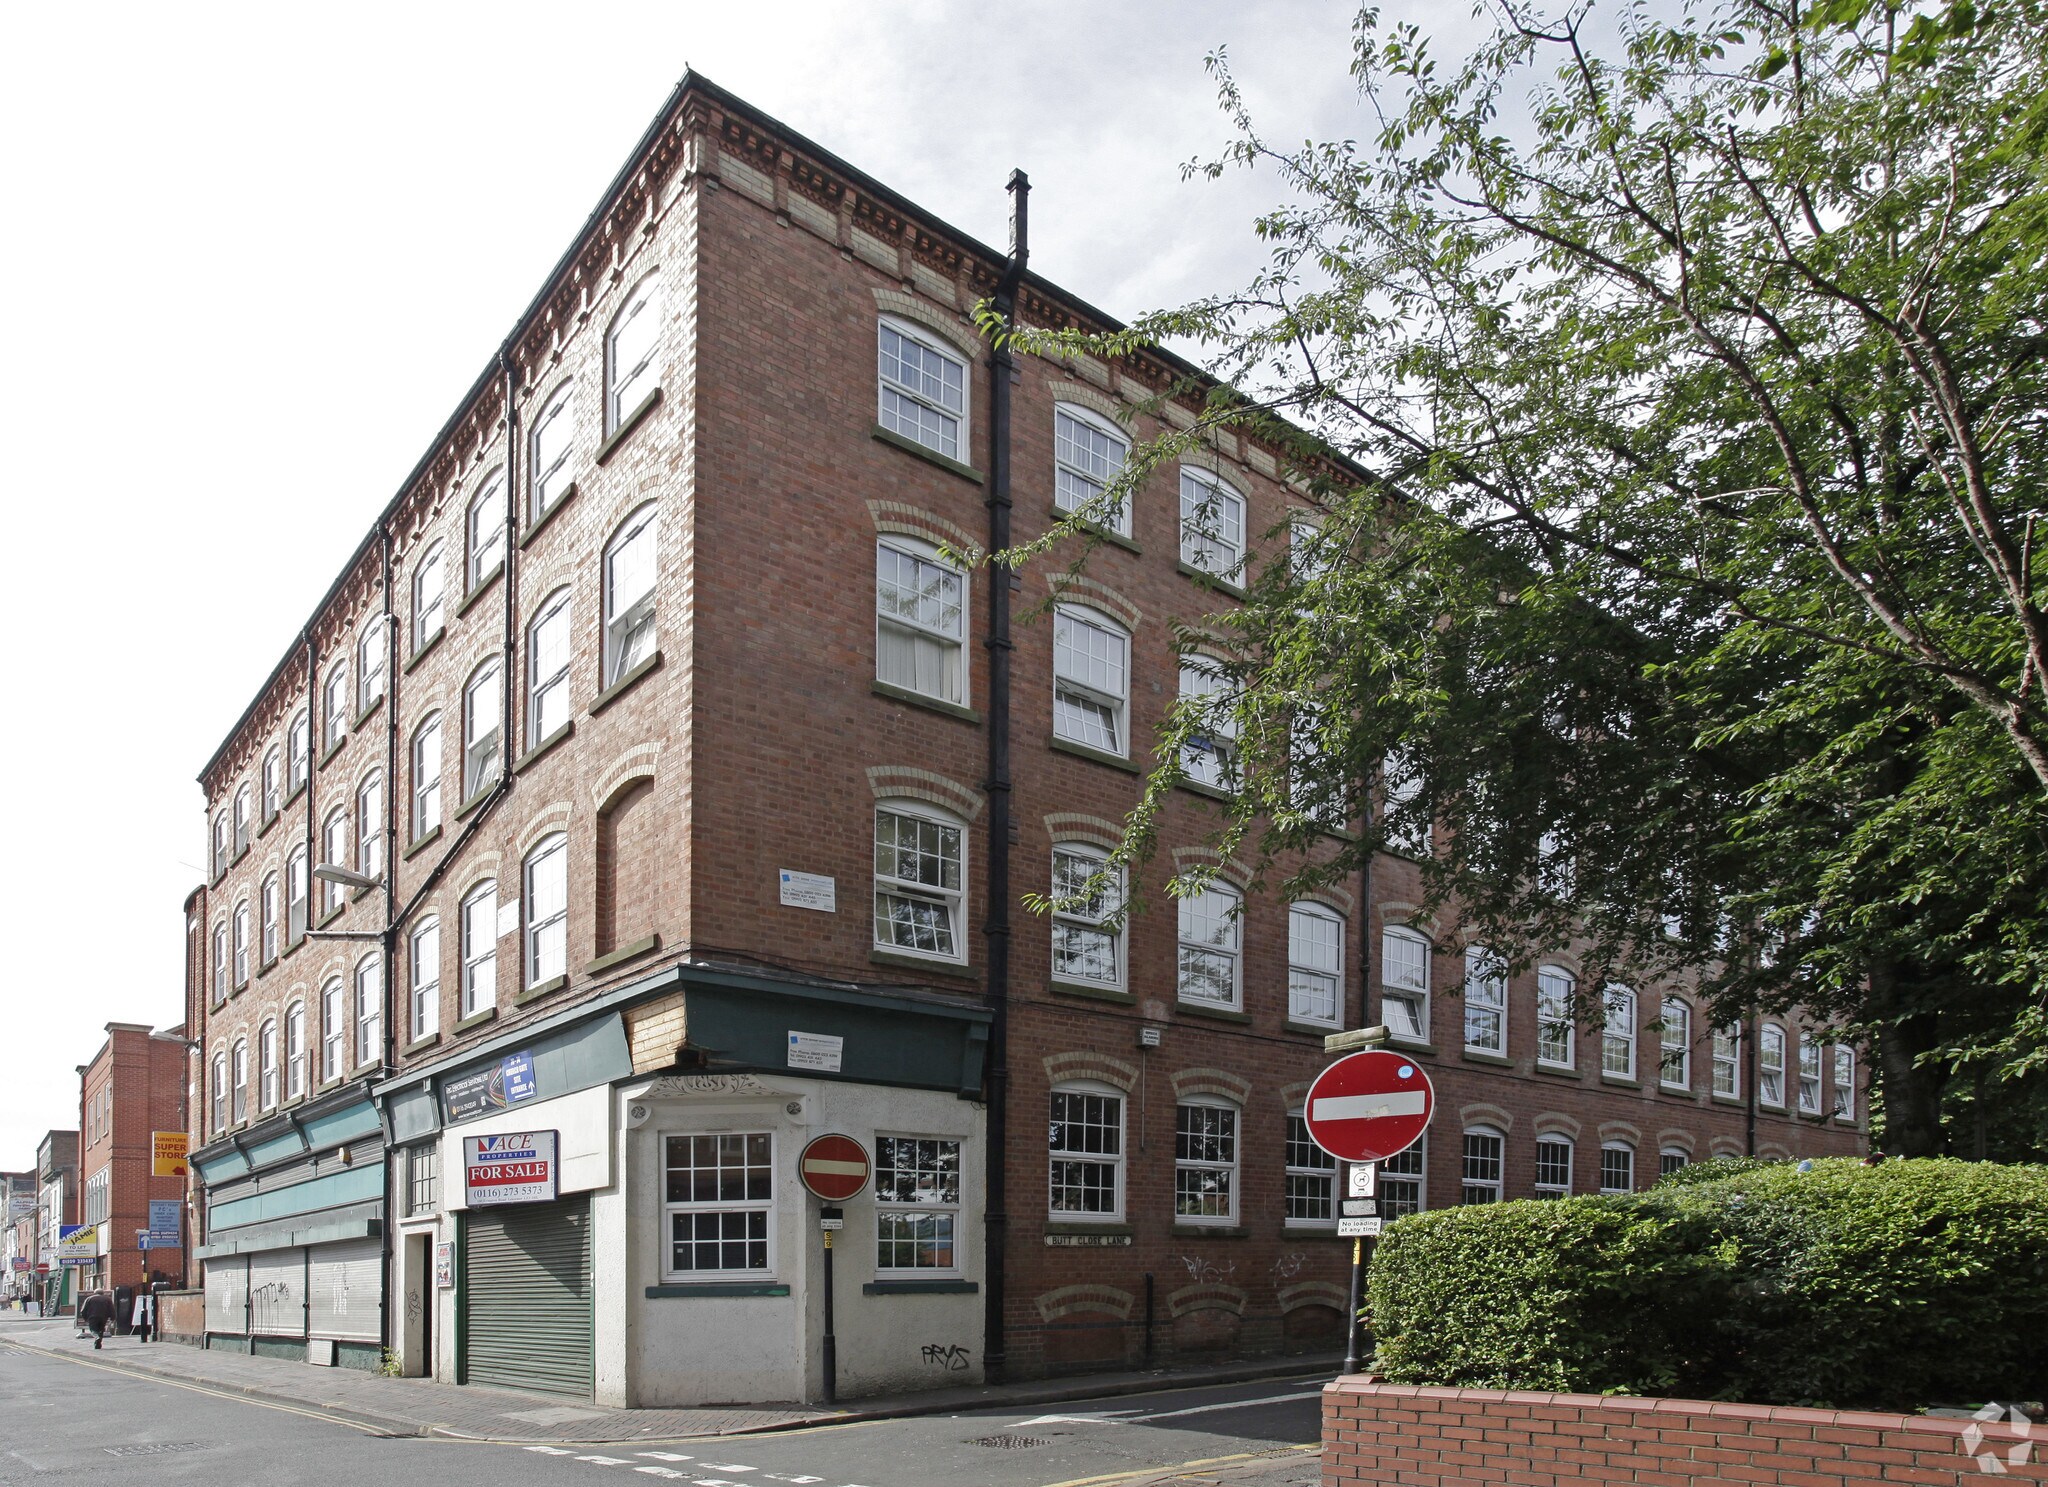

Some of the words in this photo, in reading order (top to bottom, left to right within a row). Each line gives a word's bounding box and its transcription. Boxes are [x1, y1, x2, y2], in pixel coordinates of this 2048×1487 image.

[495, 1134, 533, 1151] ACE
[481, 1151, 533, 1159] PROPERTIES
[471, 1166, 502, 1181] FOR
[505, 1163, 546, 1178] SALE
[473, 1189, 501, 1199] (0116)
[503, 1187, 519, 1196] 273
[521, 1186, 543, 1195] 5373
[60, 1224, 91, 1244] MATHER
[71, 1229, 95, 1245] JAMIE
[1052, 1236, 1072, 1244] BUTT
[1078, 1236, 1102, 1244] CLOSE
[1106, 1236, 1127, 1244] LANE
